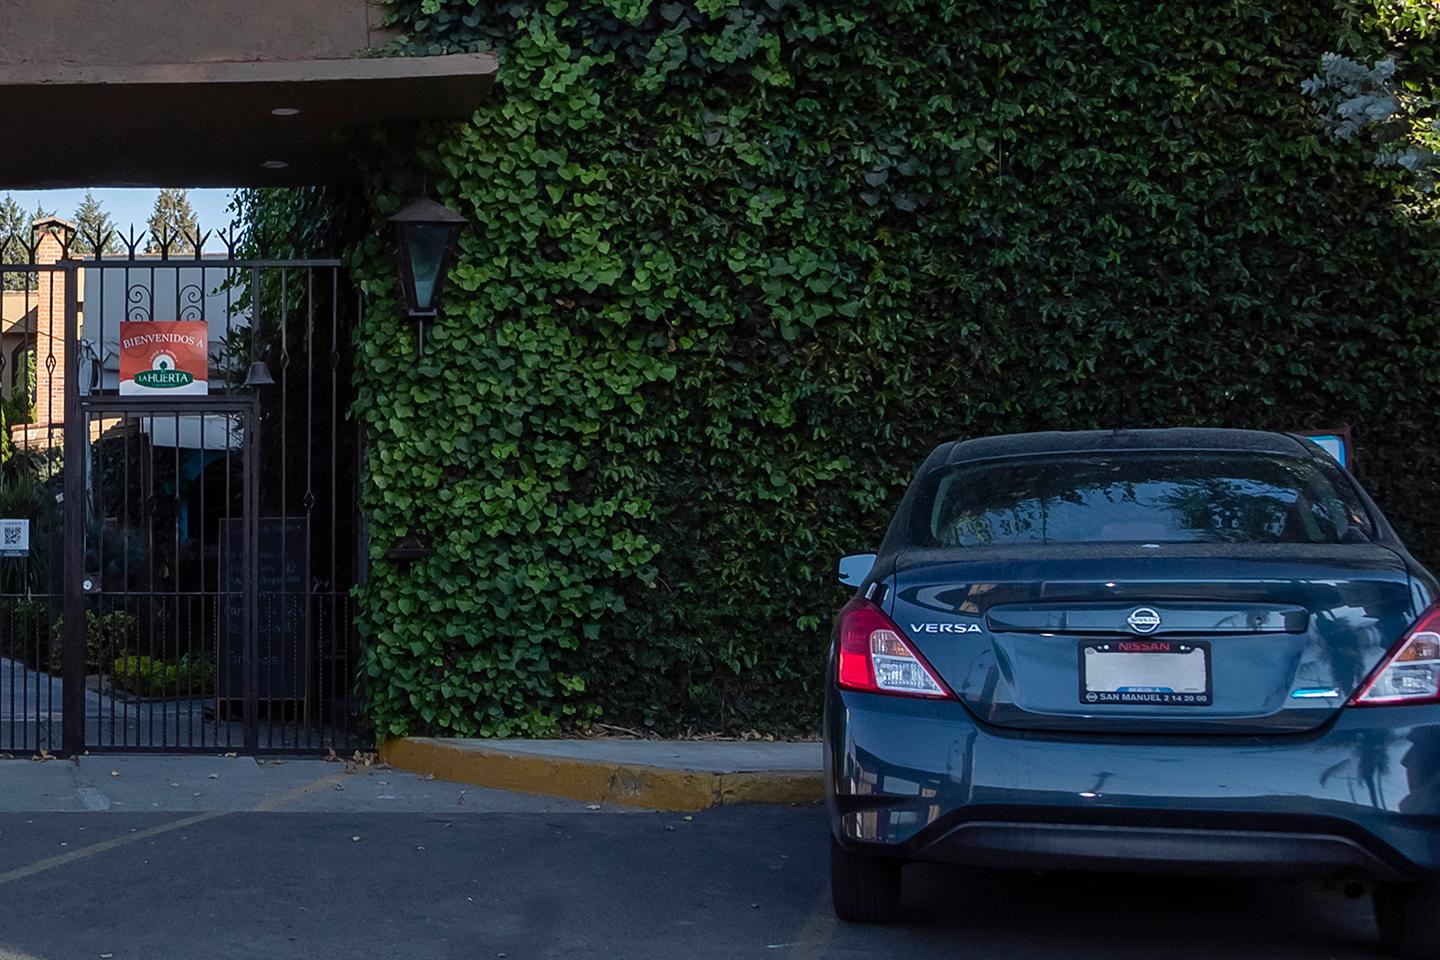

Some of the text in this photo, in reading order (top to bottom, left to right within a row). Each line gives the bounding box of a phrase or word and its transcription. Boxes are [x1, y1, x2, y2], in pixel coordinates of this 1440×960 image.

[123, 333, 204, 349] BIENVENIDOS A
[147, 373, 189, 383] HUERTA
[910, 623, 983, 634] VERSA
[1118, 642, 1170, 651] NISSAN
[1121, 694, 1162, 702] MANUEL
[1163, 694, 1170, 702] 2
